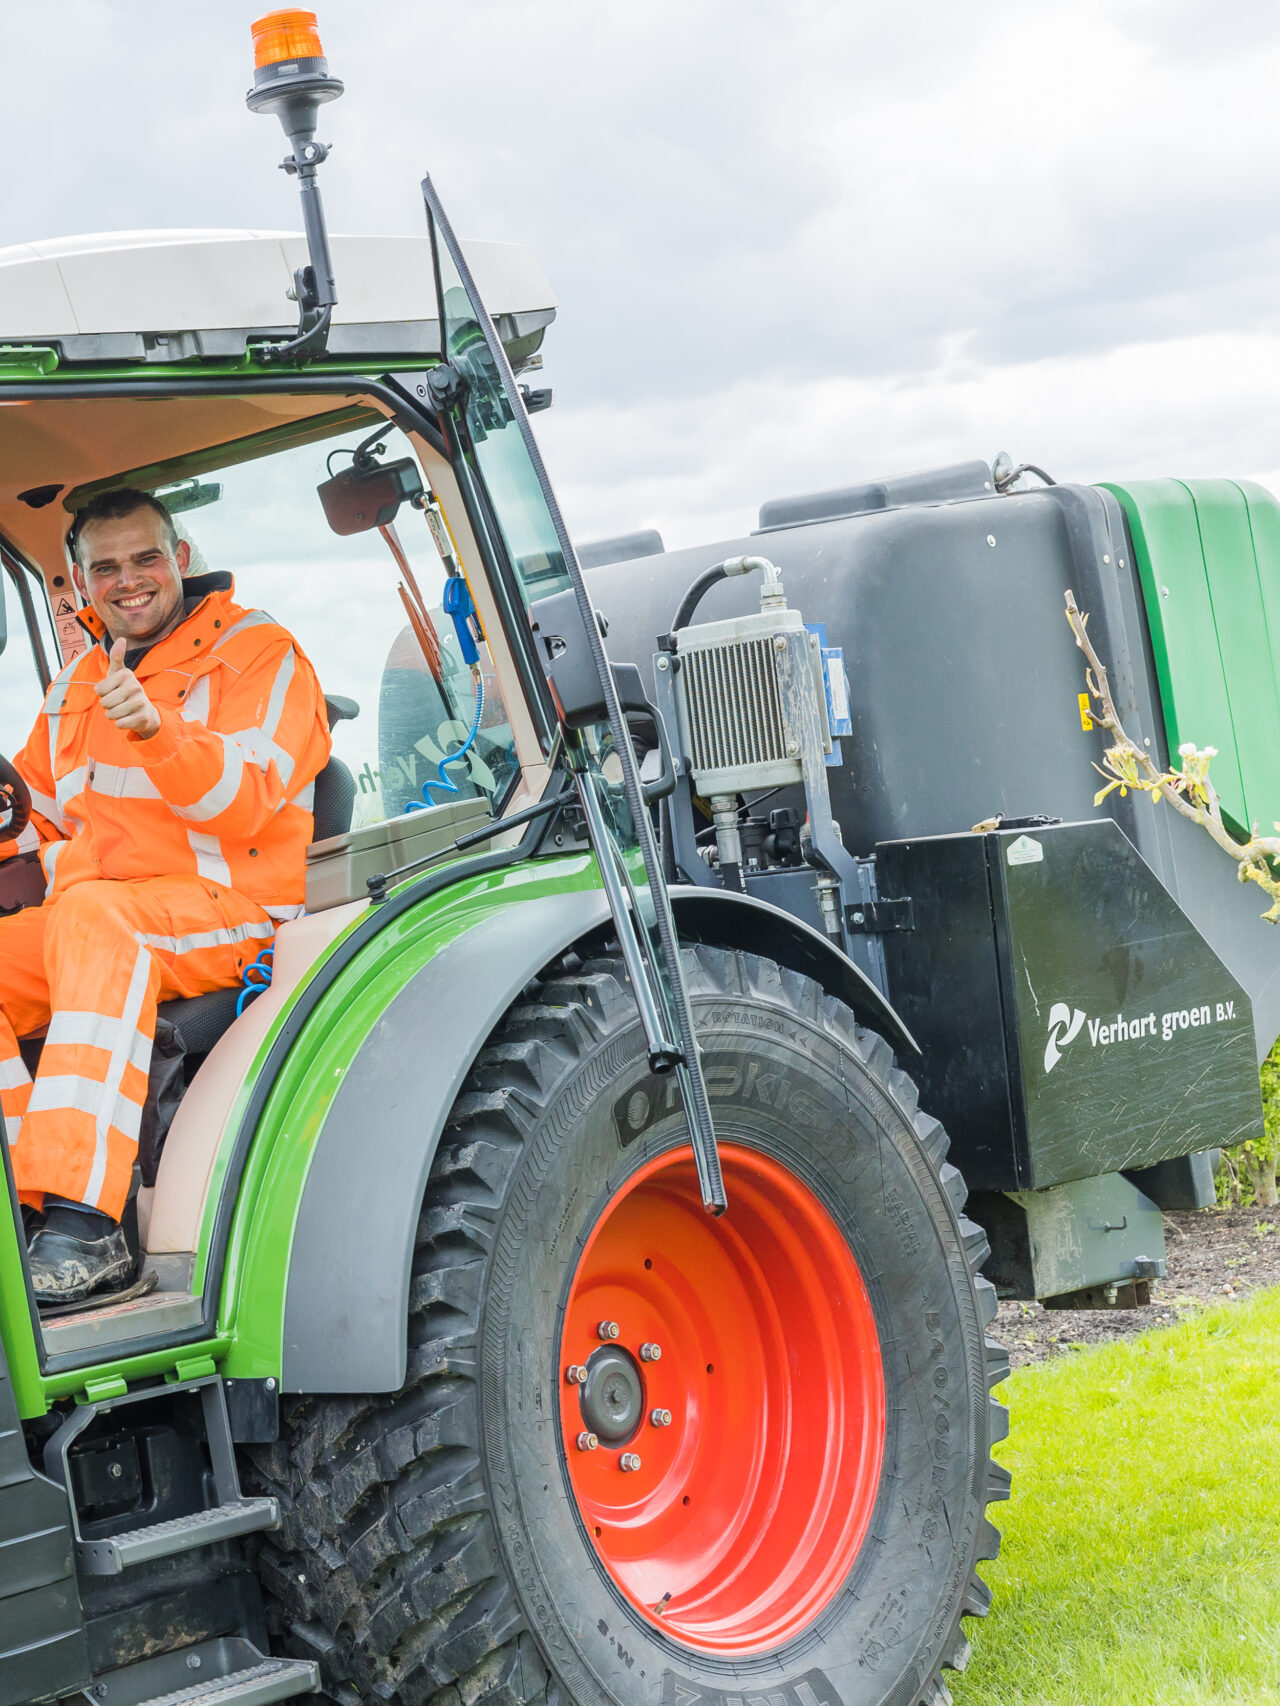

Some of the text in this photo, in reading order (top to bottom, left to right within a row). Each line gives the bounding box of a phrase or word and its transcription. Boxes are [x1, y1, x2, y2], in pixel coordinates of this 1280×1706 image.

[711, 1011, 785, 1034] ROTATION
[1087, 1001, 1236, 1047] Verhart groen B.V.
